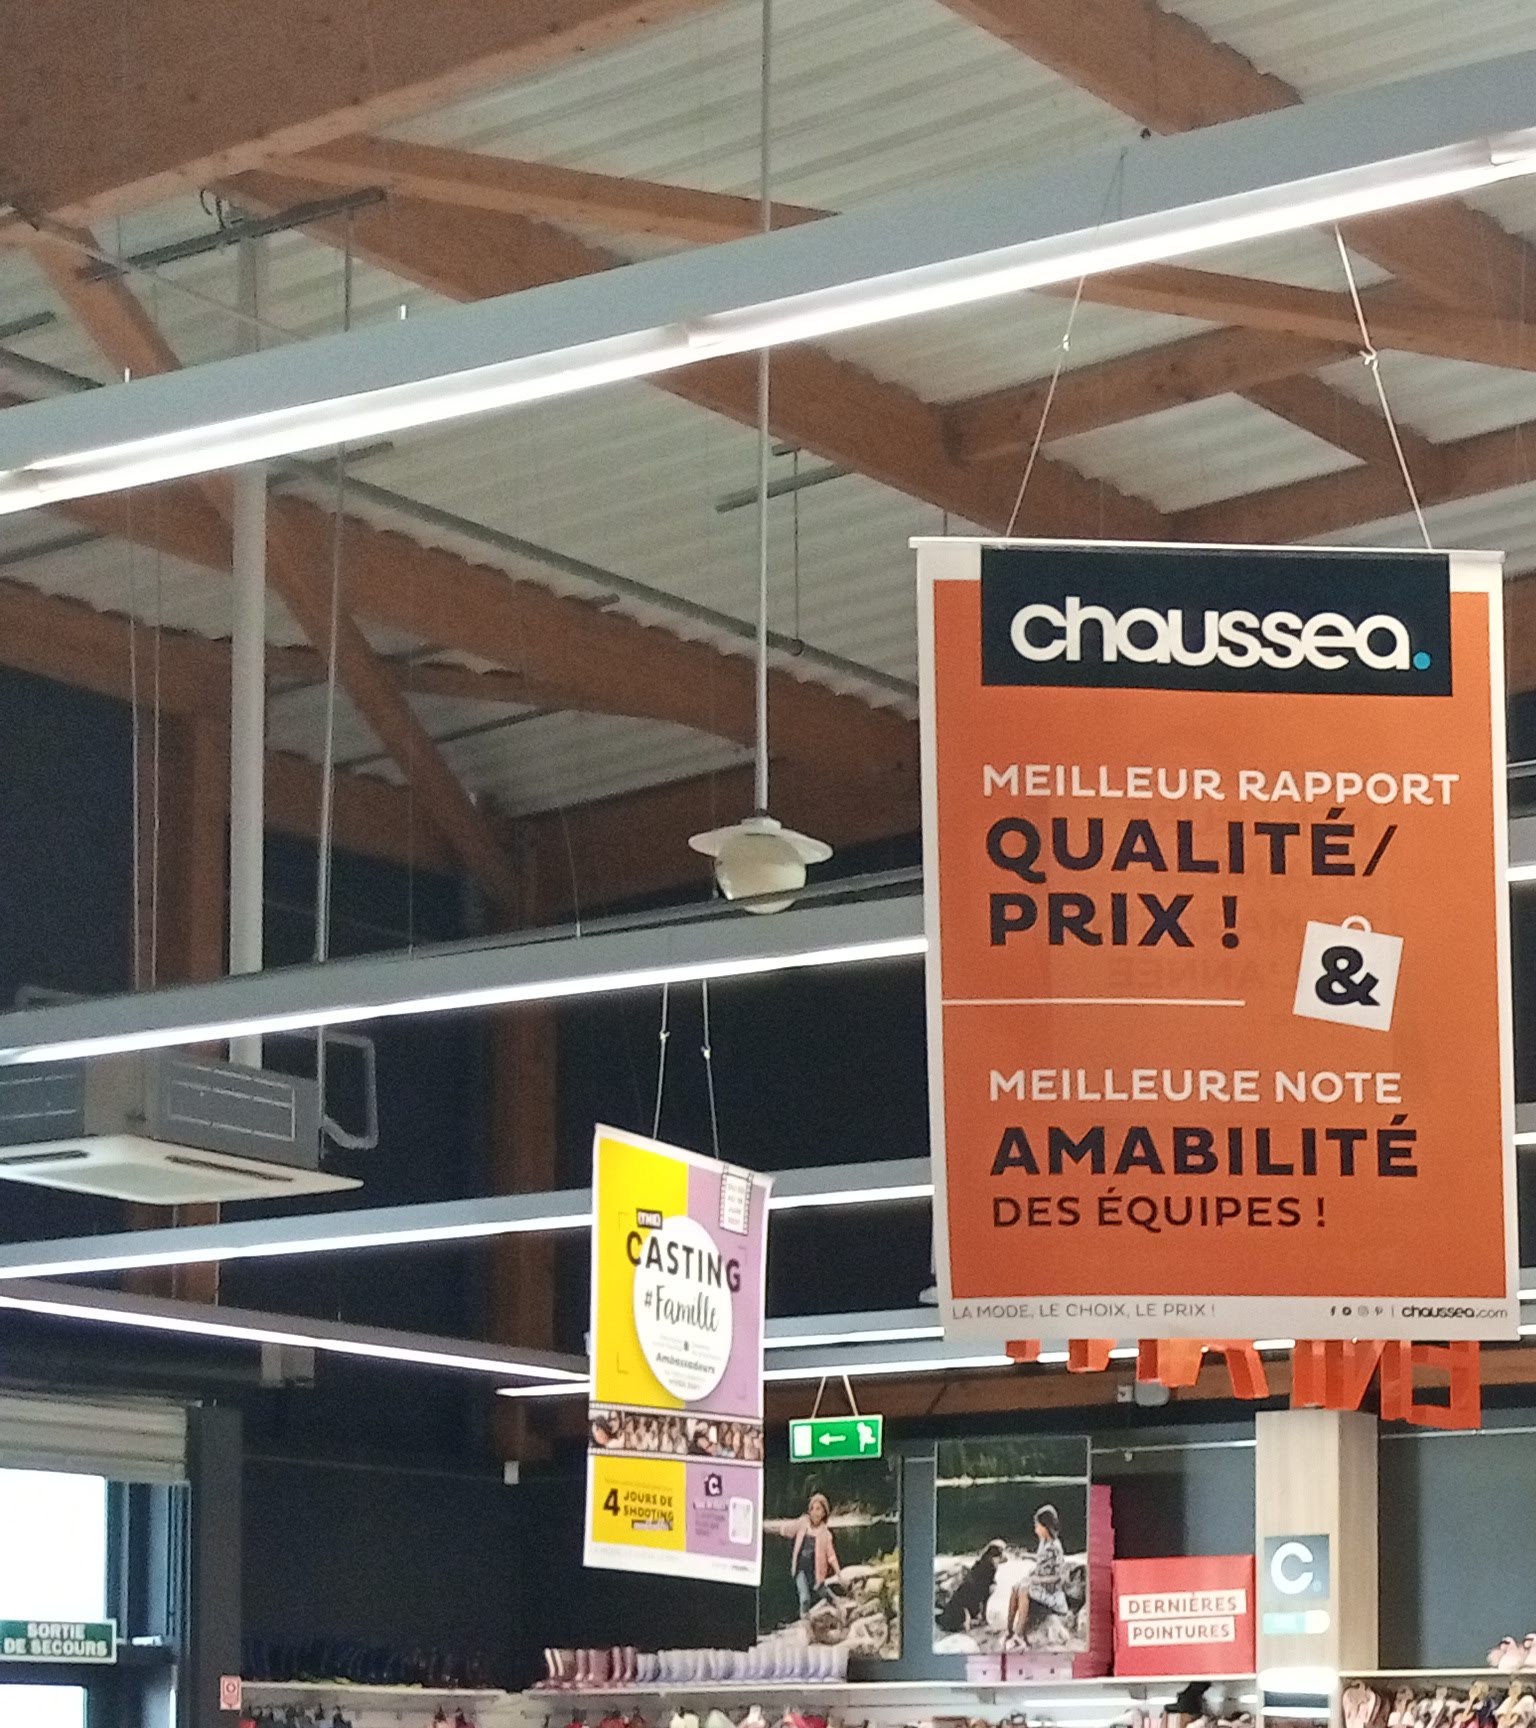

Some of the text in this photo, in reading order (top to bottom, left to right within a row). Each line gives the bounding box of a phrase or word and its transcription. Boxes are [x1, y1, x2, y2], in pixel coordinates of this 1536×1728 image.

[983, 764, 1460, 806] MEILLEUR RAPPORT
[986, 806, 1398, 884] QUALITÉ/
[990, 892, 1195, 948] PRIX
[1315, 945, 1381, 1007] &
[989, 1069, 1402, 1105] MEILLEURE NOTE
[990, 1113, 1419, 1178] AMABILITÉ
[992, 1195, 1078, 1229] DES
[1097, 1186, 1302, 1233] ÉQUIPES
[626, 1231, 741, 1293] CASTING
[644, 1284, 720, 1332] #Famille
[951, 1305, 974, 1320] LA
[976, 1304, 1034, 1321] MODE,
[1039, 1304, 1060, 1318] LE
[1065, 1303, 1131, 1320] CHOIX,
[1136, 1303, 1157, 1318] LE
[1162, 1302, 1206, 1318] PRIX
[1401, 1302, 1509, 1320] chaussea.com
[602, 1488, 674, 1517] 4 JOURS DE
[623, 1506, 674, 1523] SHOOTING
[1127, 1591, 1239, 1616] DERNIÈRES
[3, 1637, 108, 1657] DE SECOURS
[27, 1622, 86, 1641] SORTIE
[1132, 1620, 1231, 1642] POINTURES
